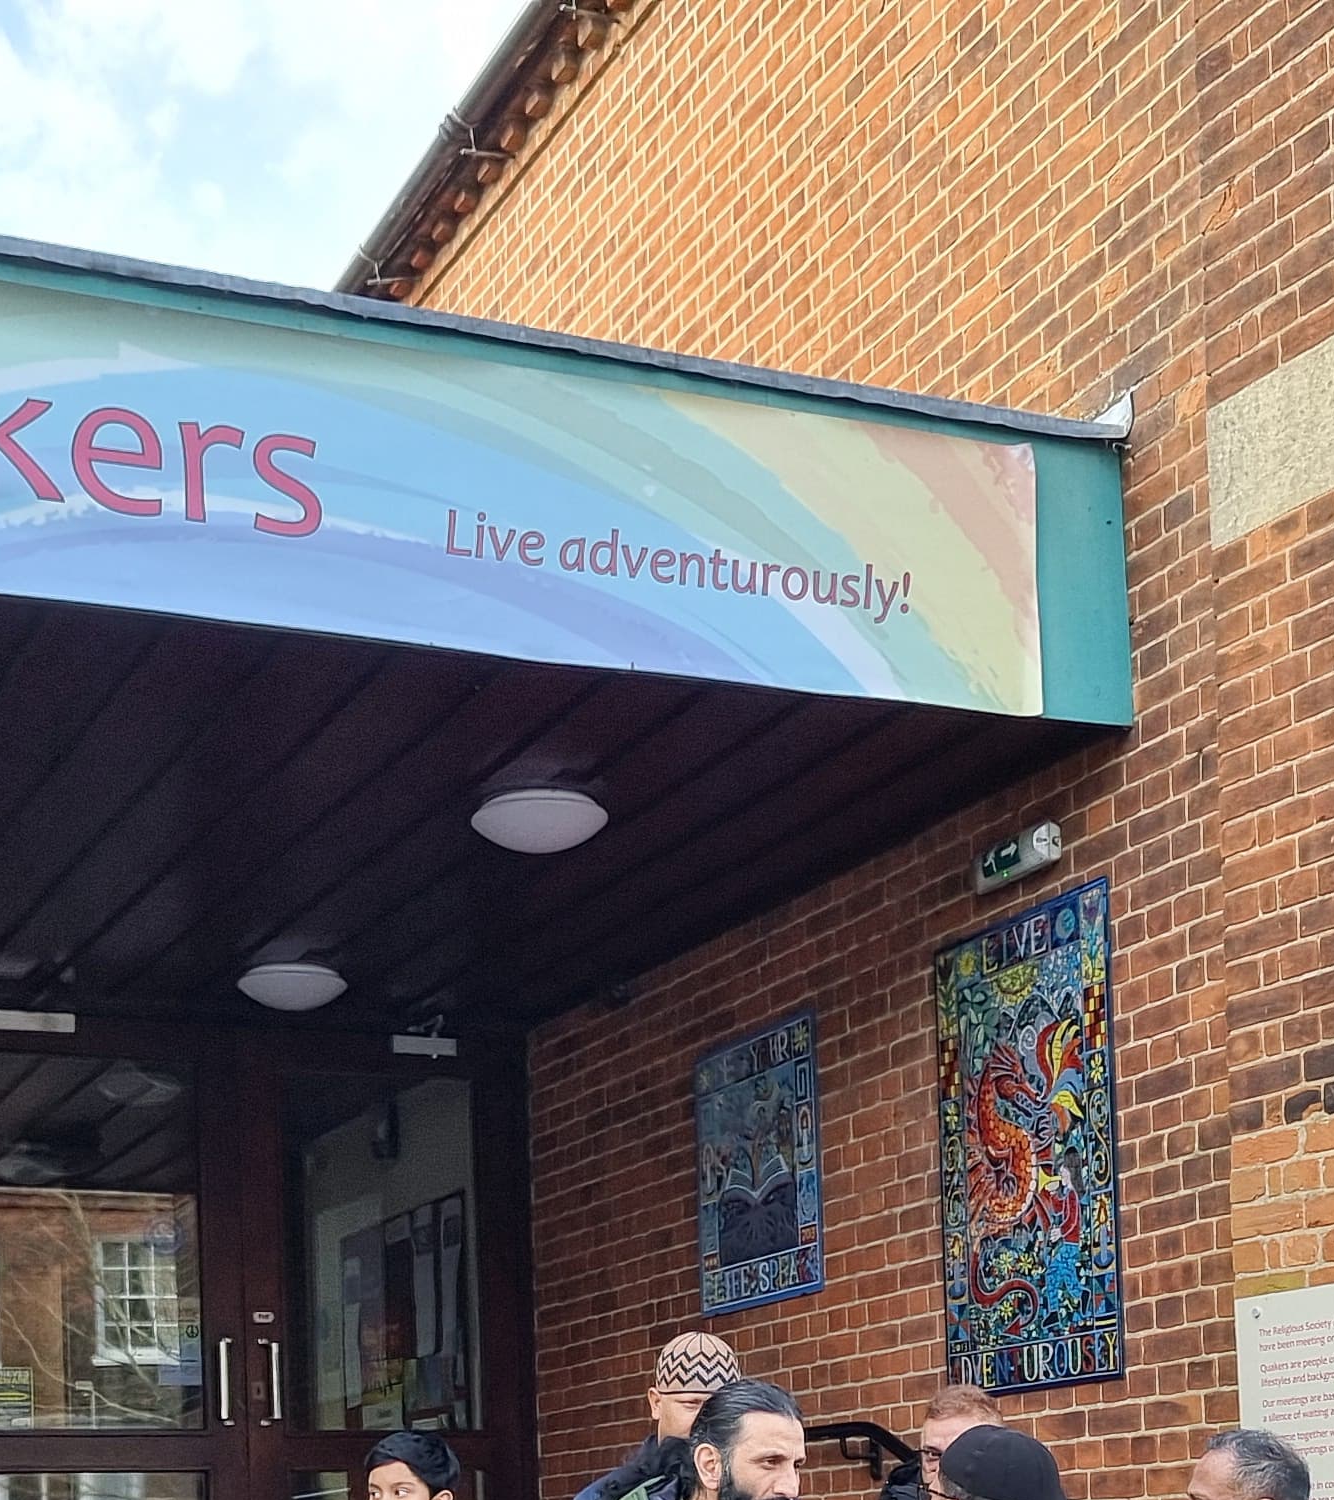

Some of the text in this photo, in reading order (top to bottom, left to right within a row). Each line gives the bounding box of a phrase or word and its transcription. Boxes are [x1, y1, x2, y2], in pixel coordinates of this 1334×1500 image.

[445, 509, 912, 624] Live adventurously!
[982, 914, 1048, 974] LIVE
[1259, 1328, 1271, 1337] The
[1273, 1324, 1304, 1336] Religious
[1305, 1320, 1331, 1332] Society
[1259, 1342, 1276, 1352] have
[1277, 1339, 1295, 1349] been
[1296, 1336, 1325, 1348] meeting
[1260, 1362, 1288, 1374] Quakers
[1290, 1360, 1301, 1369] are
[1303, 1355, 1328, 1369] people
[1261, 1375, 1291, 1388] lifestyles
[1292, 1373, 1305, 1383] and
[1263, 1399, 1275, 1408] Our
[1277, 1395, 1308, 1408] meetings
[1310, 1393, 1321, 1402] are
[1269, 1411, 1292, 1422] silence
[1294, 1410, 1301, 1420] of
[1303, 1406, 1329, 1418] waiting
[1297, 1429, 1328, 1443] together
